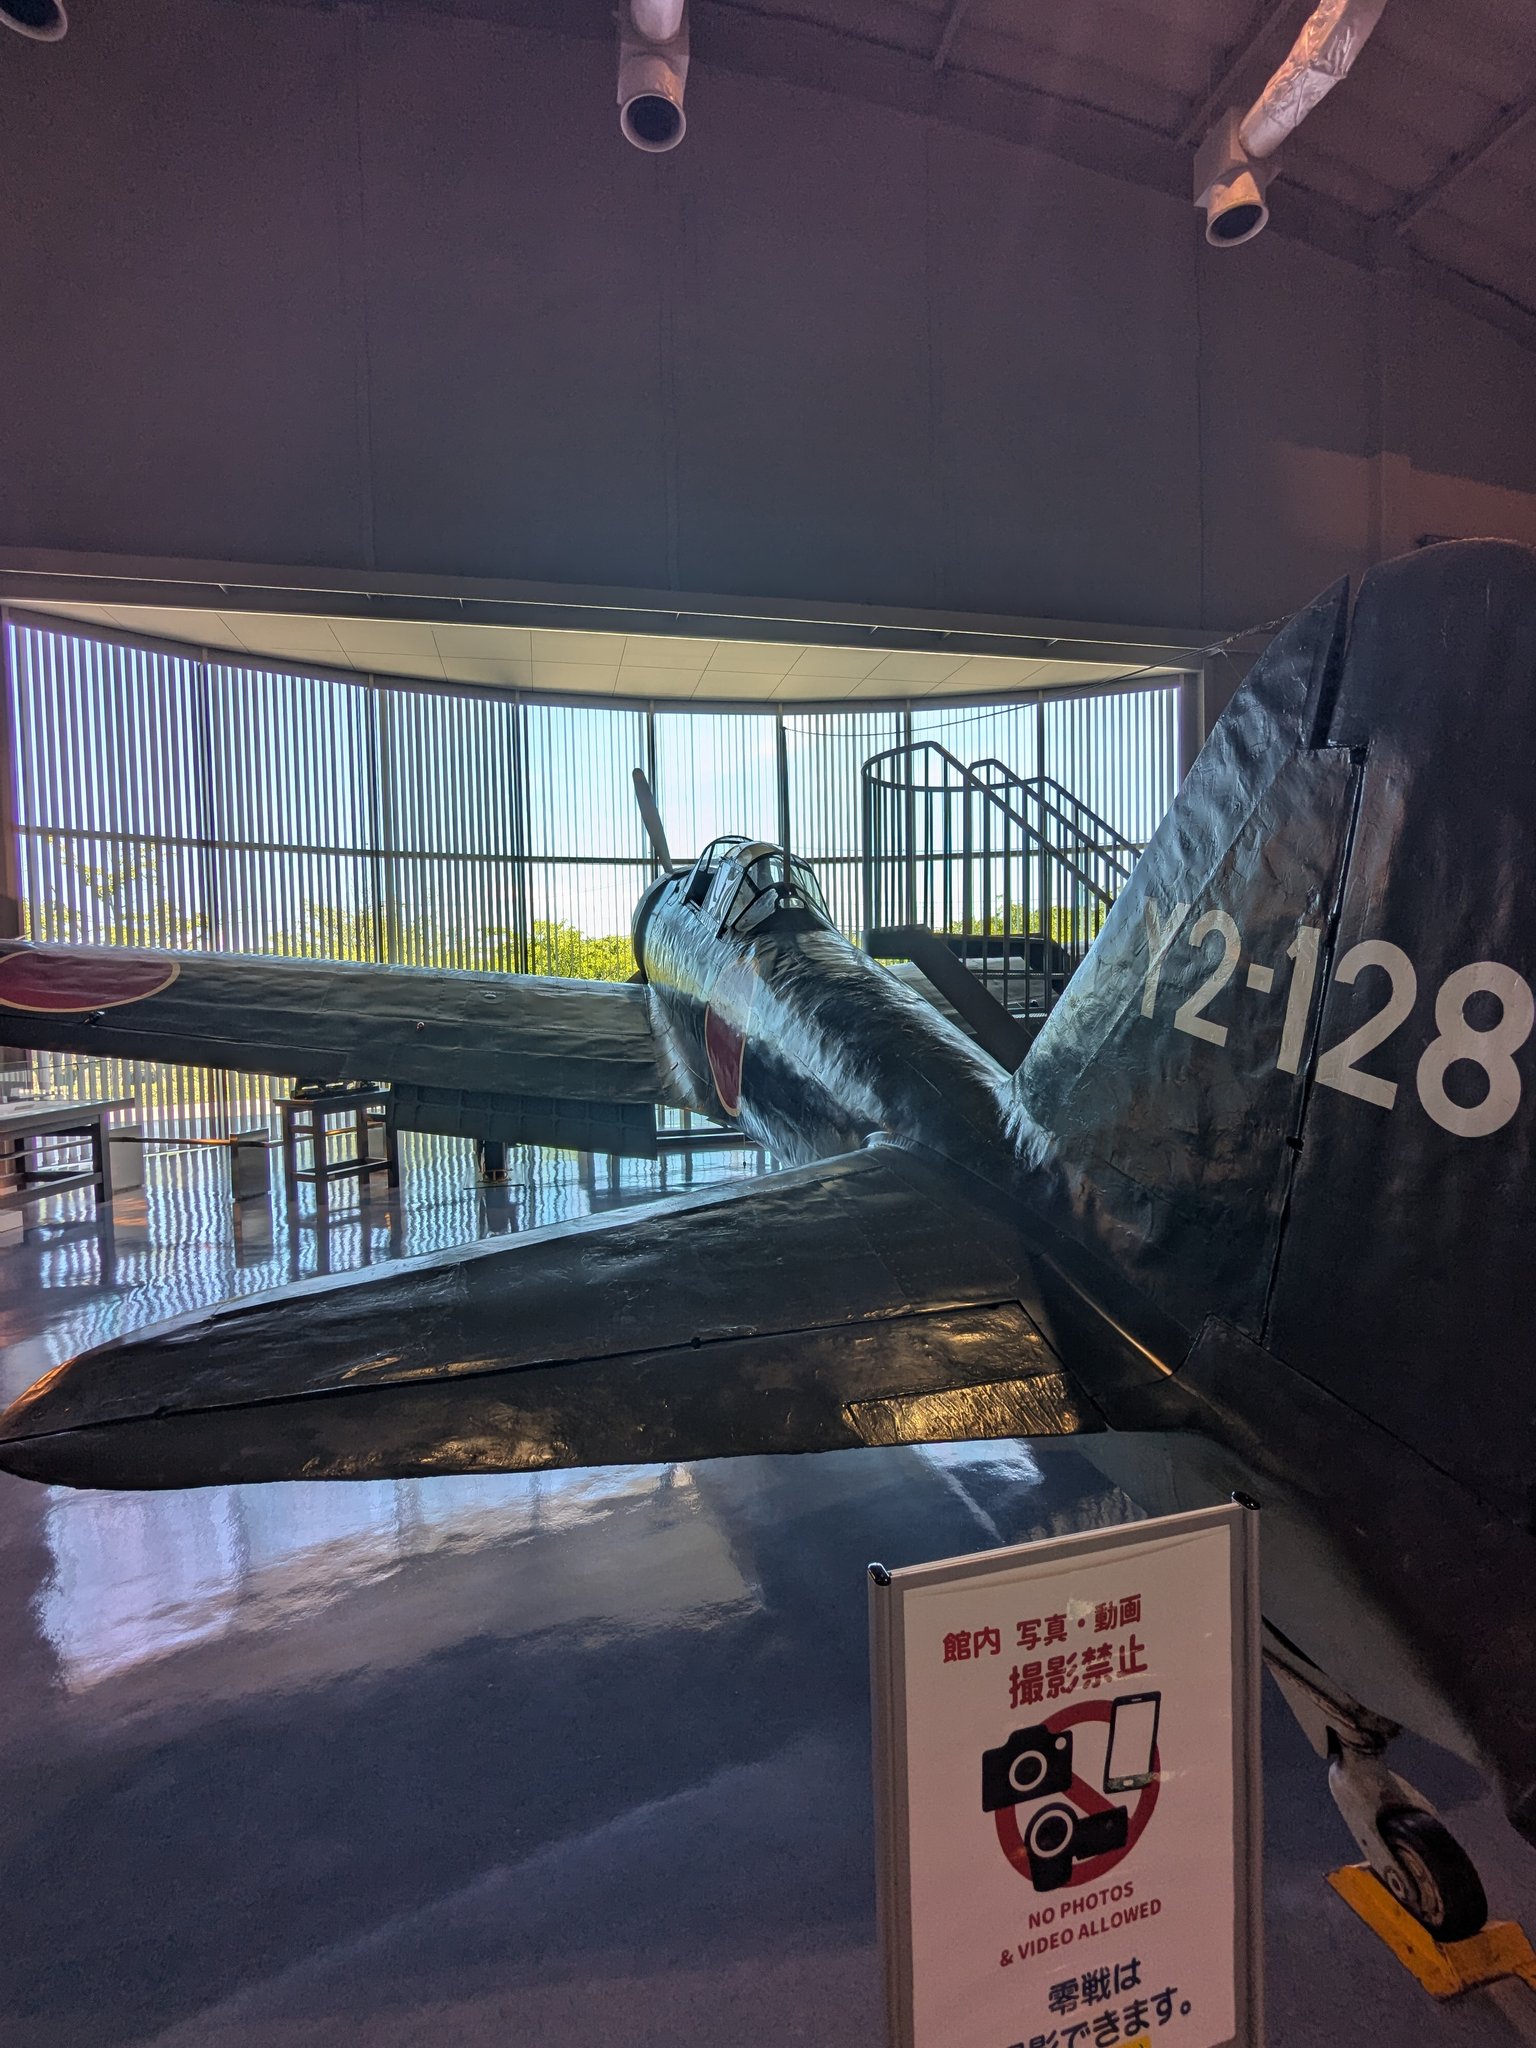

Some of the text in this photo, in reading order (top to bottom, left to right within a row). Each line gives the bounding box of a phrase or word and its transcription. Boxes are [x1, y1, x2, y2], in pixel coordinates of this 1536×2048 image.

[1140, 895, 1535, 1138] Y2-128
[942, 1593, 1142, 1663] 館内 写真・動画
[1008, 1633, 1148, 1710] 撮影禁止
[1000, 1898, 1162, 1967] & VIDEO ALLOWED
[1028, 1881, 1134, 1929] NO PHOTOS
[1006, 1986, 1192, 2048] できます。
[1048, 1957, 1141, 2016] 零戦は
